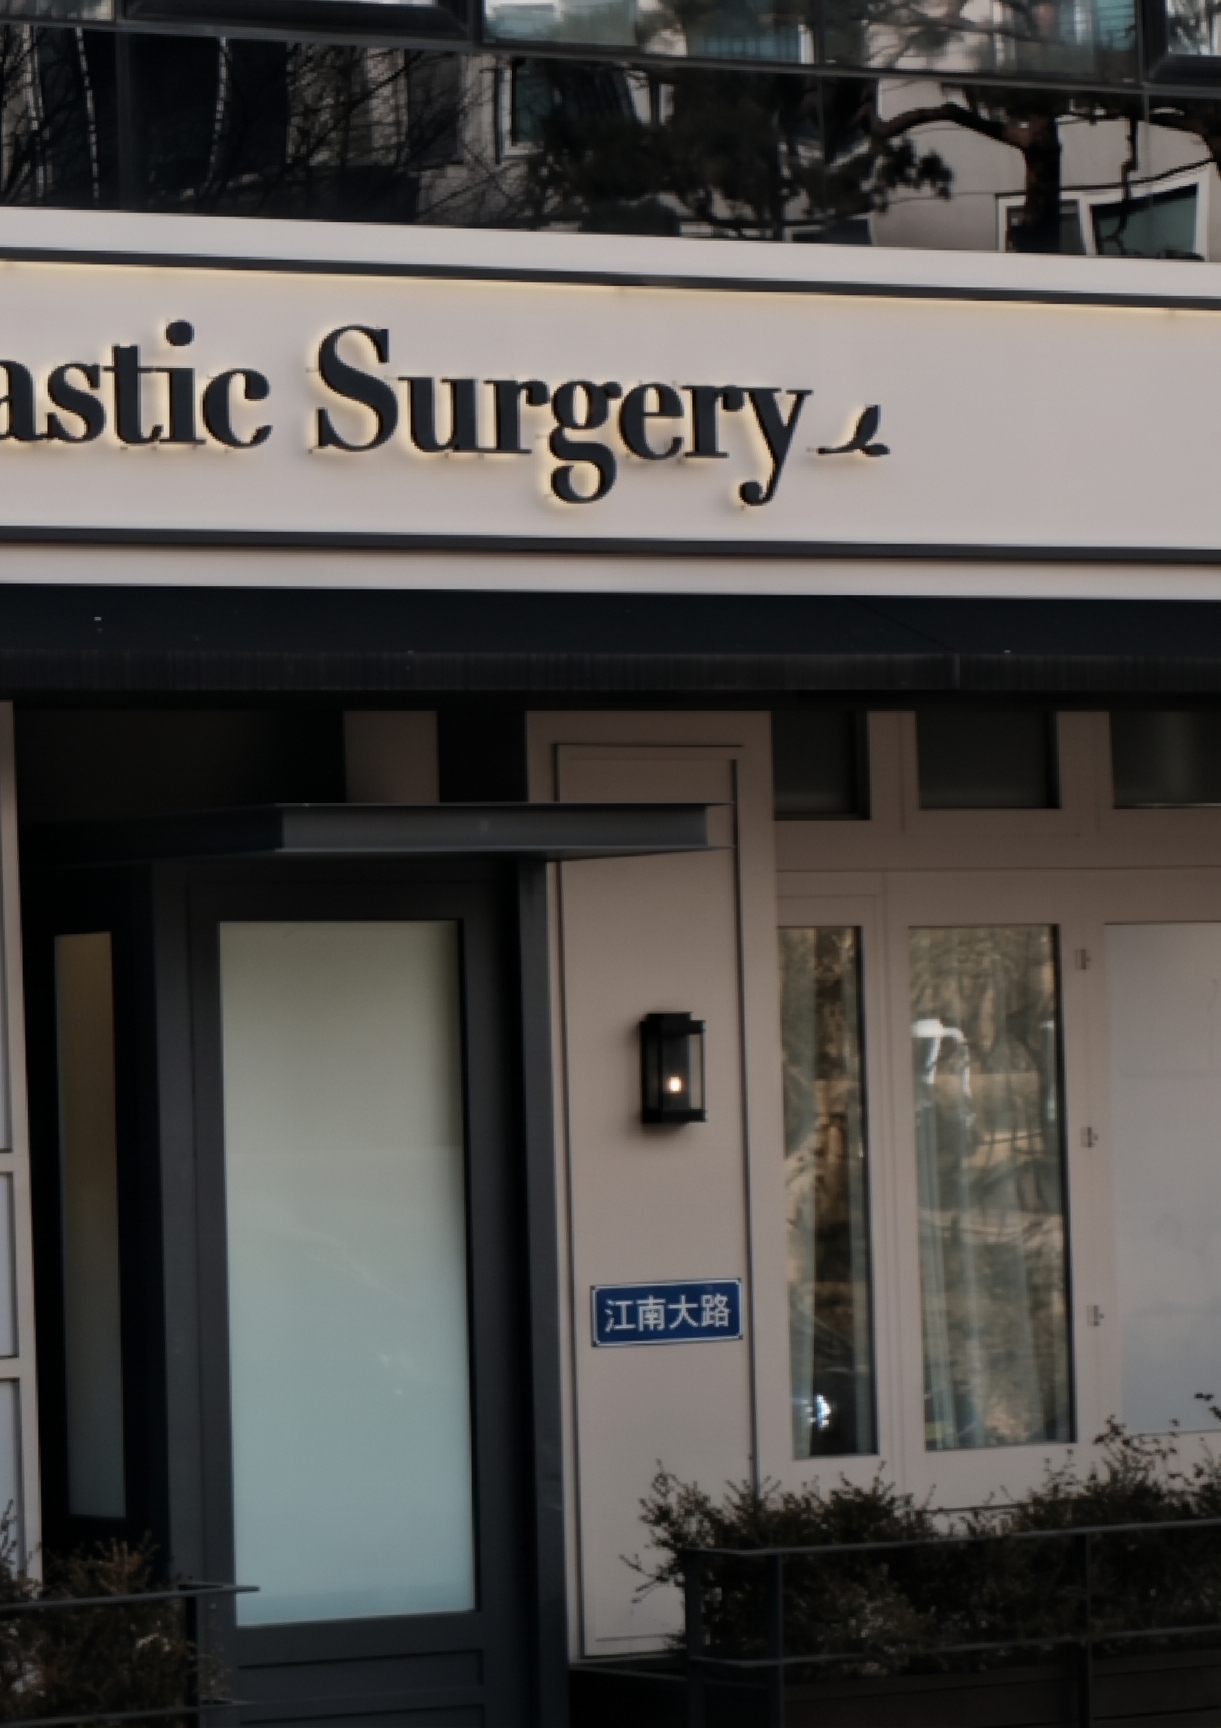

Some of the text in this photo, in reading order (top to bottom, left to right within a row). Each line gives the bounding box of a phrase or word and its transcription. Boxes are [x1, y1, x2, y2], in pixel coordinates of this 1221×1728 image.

[315, 324, 814, 507] Surgery
[603, 1293, 732, 1333] 江南大路
